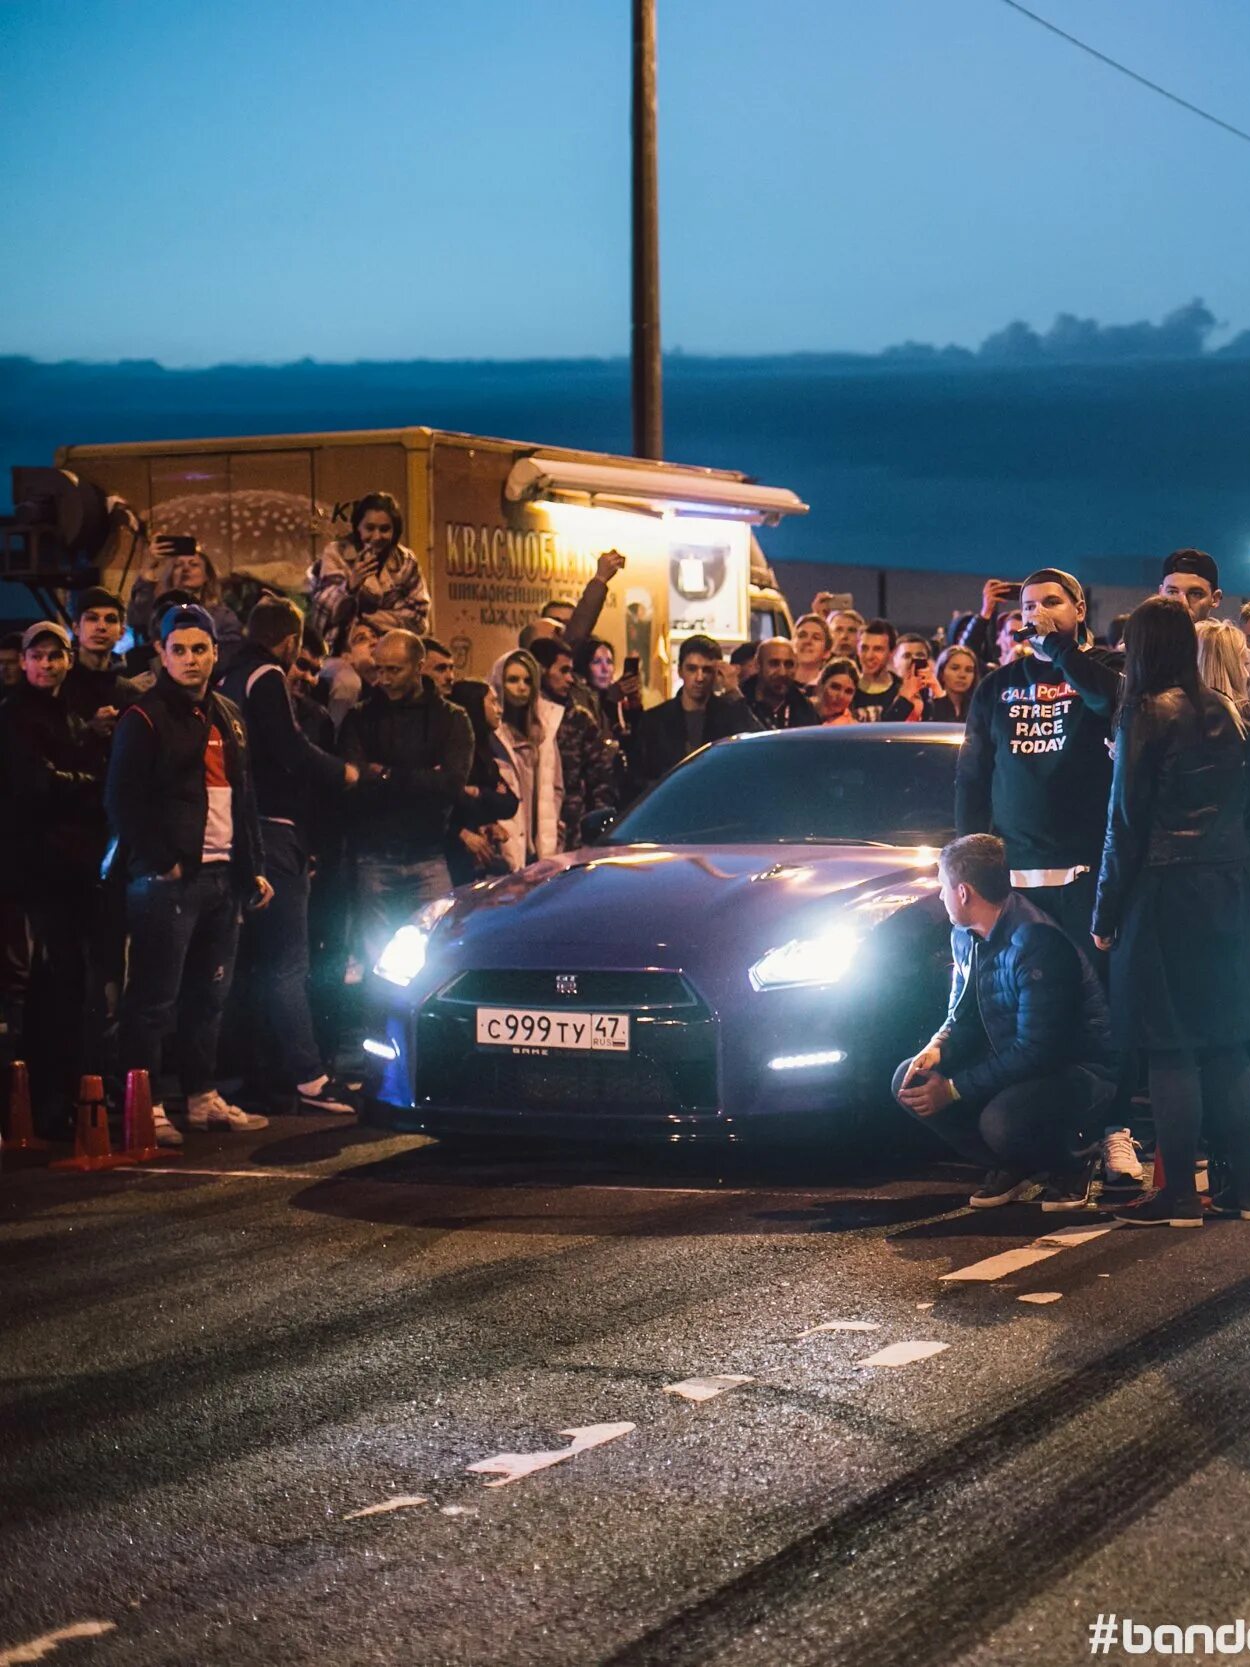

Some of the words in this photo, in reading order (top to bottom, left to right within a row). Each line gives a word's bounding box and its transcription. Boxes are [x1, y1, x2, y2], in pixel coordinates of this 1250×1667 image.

[1009, 699, 1072, 719] STREET
[1016, 719, 1064, 737] RACE
[1010, 735, 1067, 754] TODAY
[595, 1016, 620, 1038] 47
[593, 1038, 613, 1047] RUS
